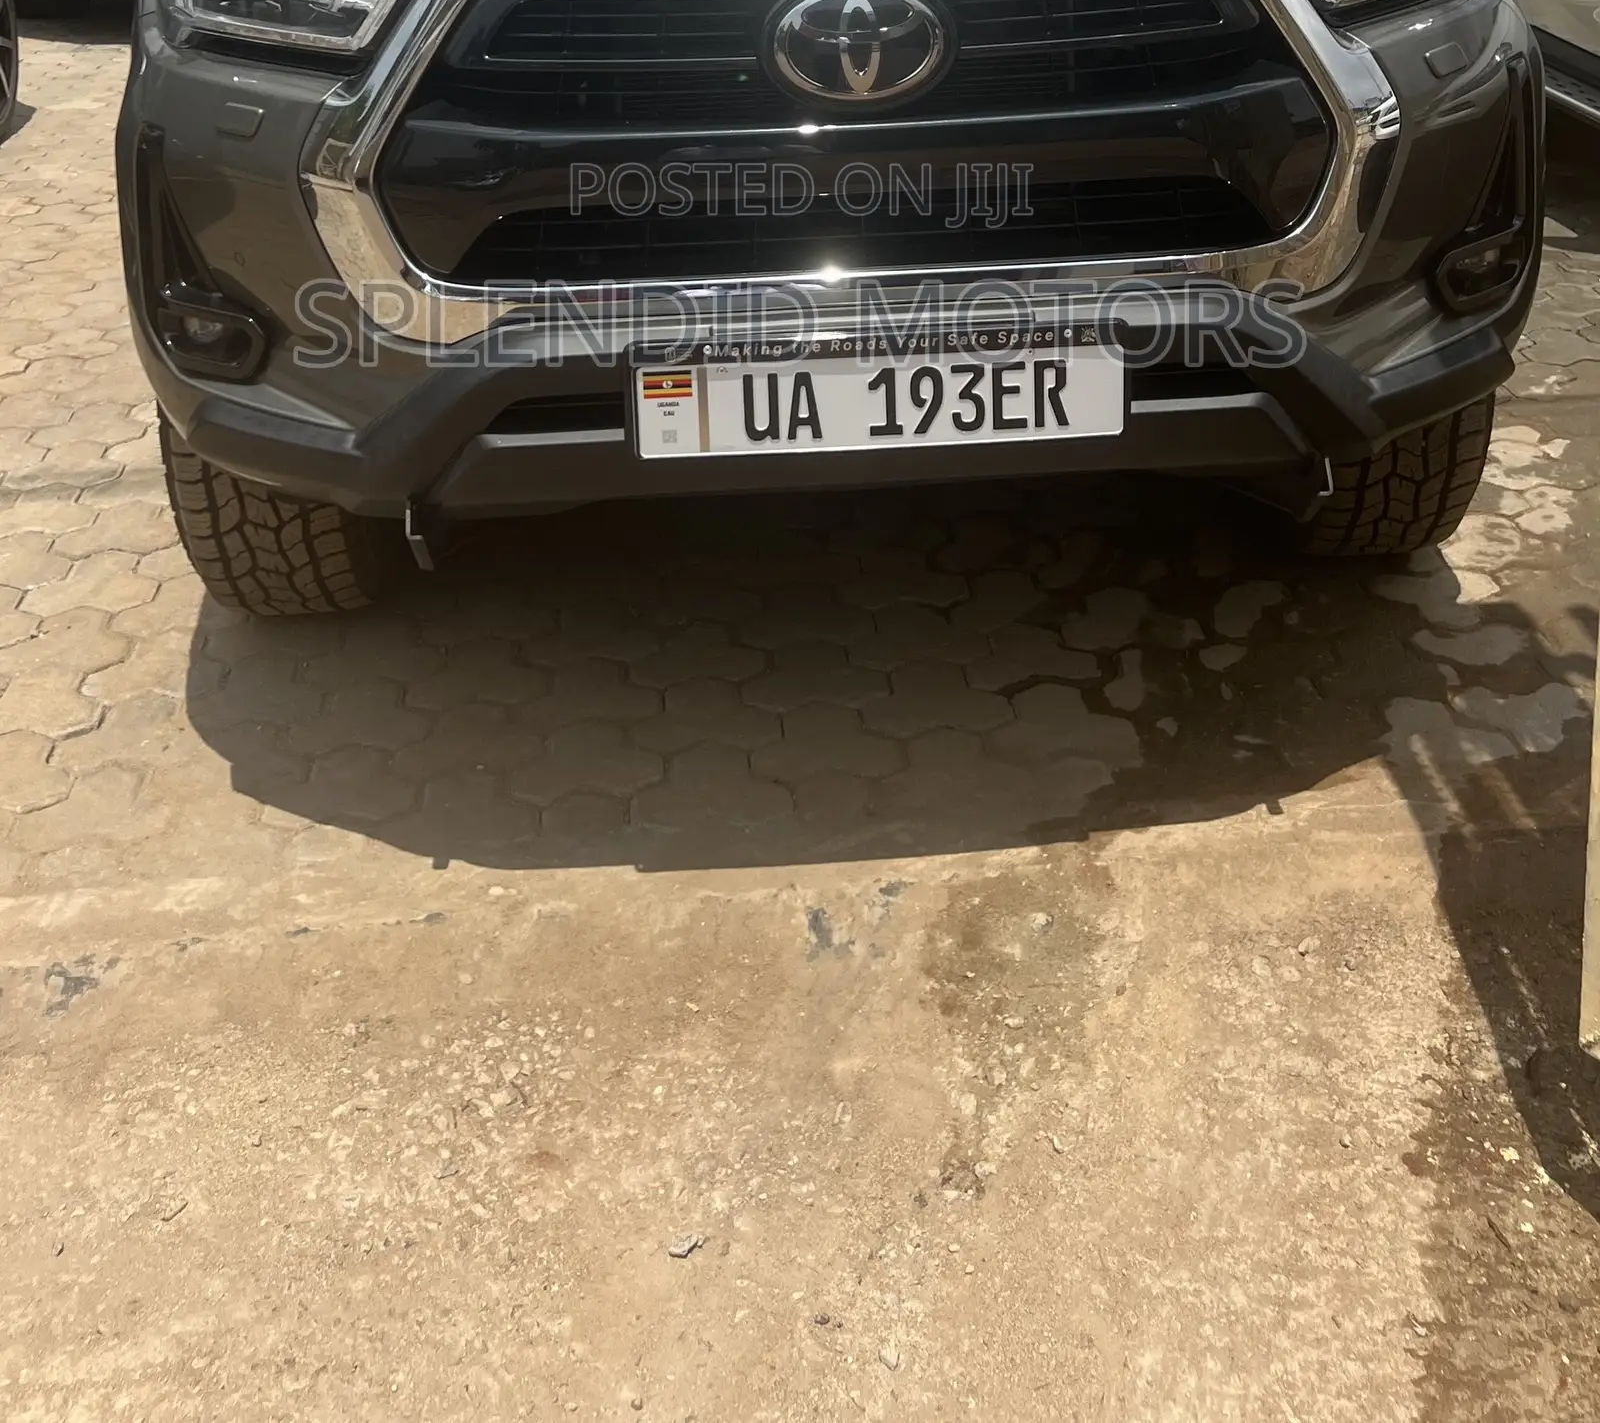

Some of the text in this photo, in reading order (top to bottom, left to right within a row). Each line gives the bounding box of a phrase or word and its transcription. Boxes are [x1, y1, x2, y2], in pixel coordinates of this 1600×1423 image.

[714, 329, 1055, 359] Making the Roads Your Safe Space
[742, 358, 1071, 442] UA 193ER
